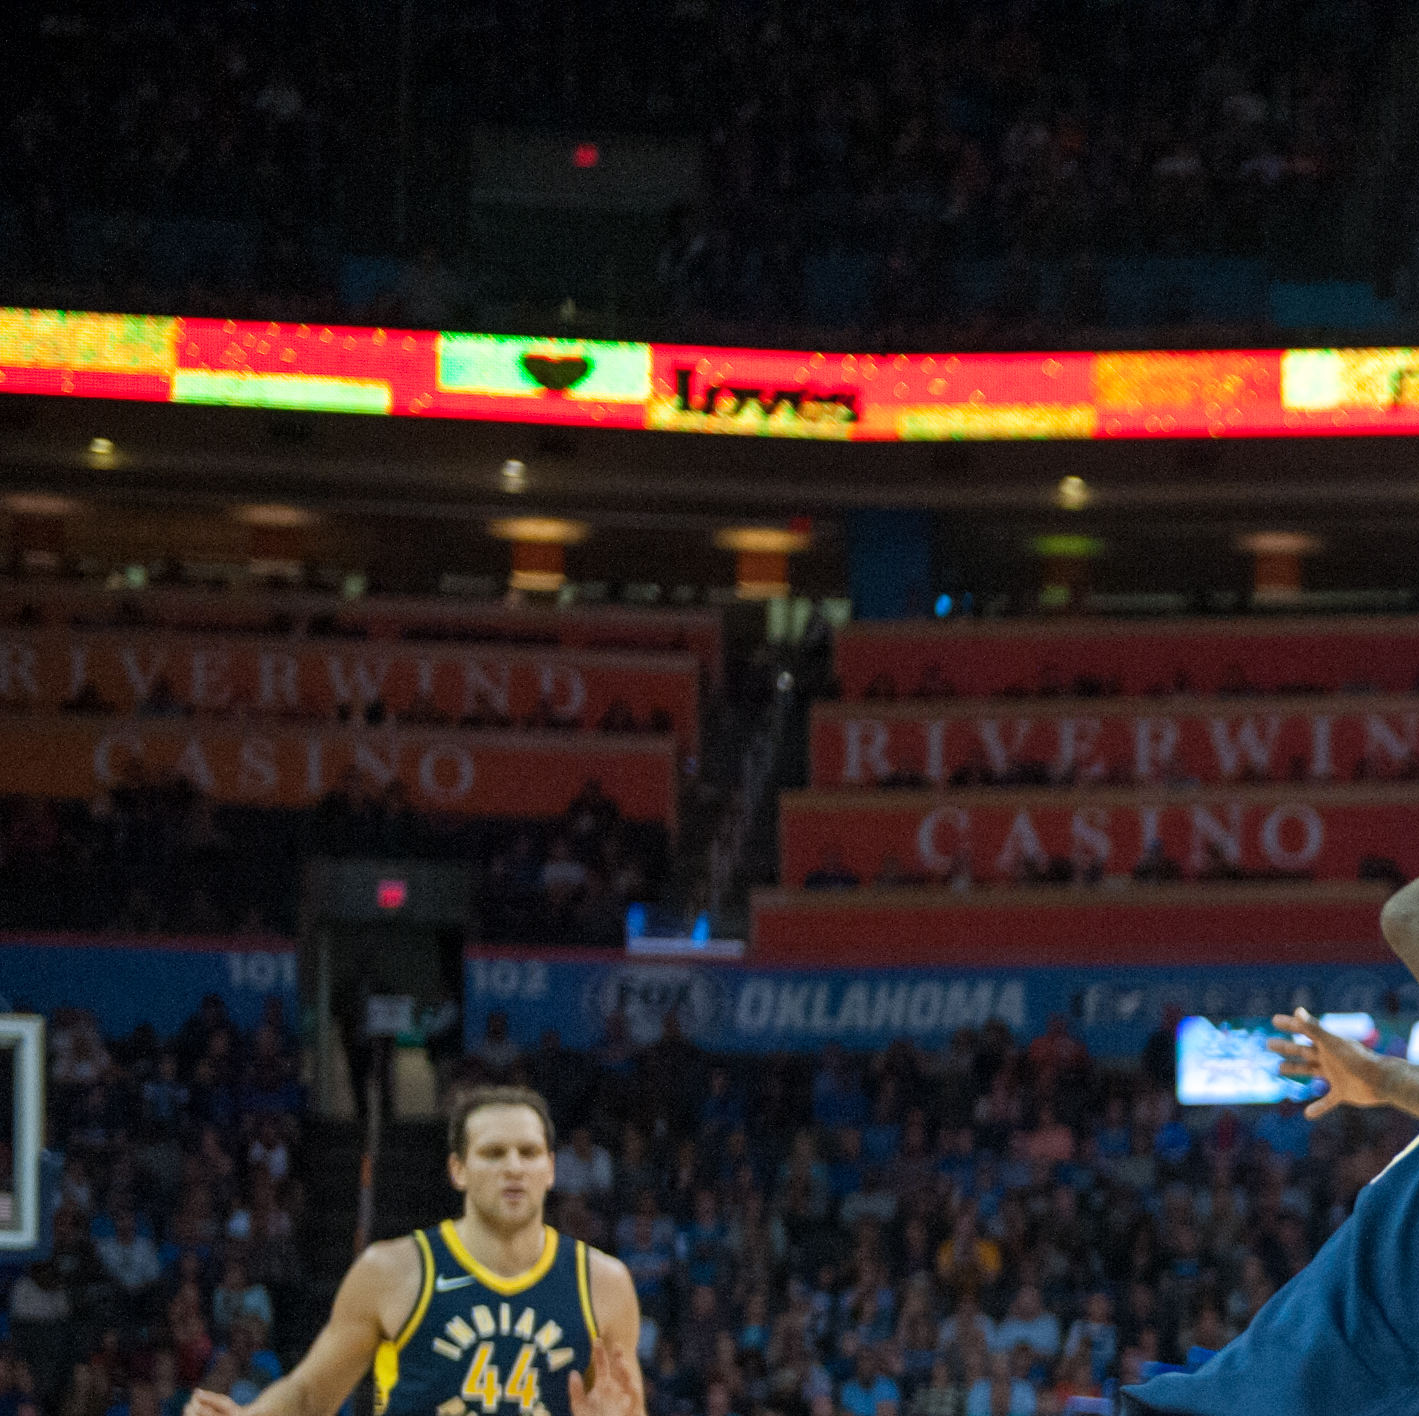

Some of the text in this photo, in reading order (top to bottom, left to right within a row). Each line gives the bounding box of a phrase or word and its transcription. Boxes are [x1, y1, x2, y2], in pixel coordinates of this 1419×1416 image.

[90, 731, 475, 801] CASINO
[916, 801, 1325, 871] CASINO
[228, 952, 296, 988] 101
[733, 979, 1029, 1035] OKLAHOMA
[432, 1302, 575, 1373] INDIANA
[461, 1340, 541, 1414] 44
